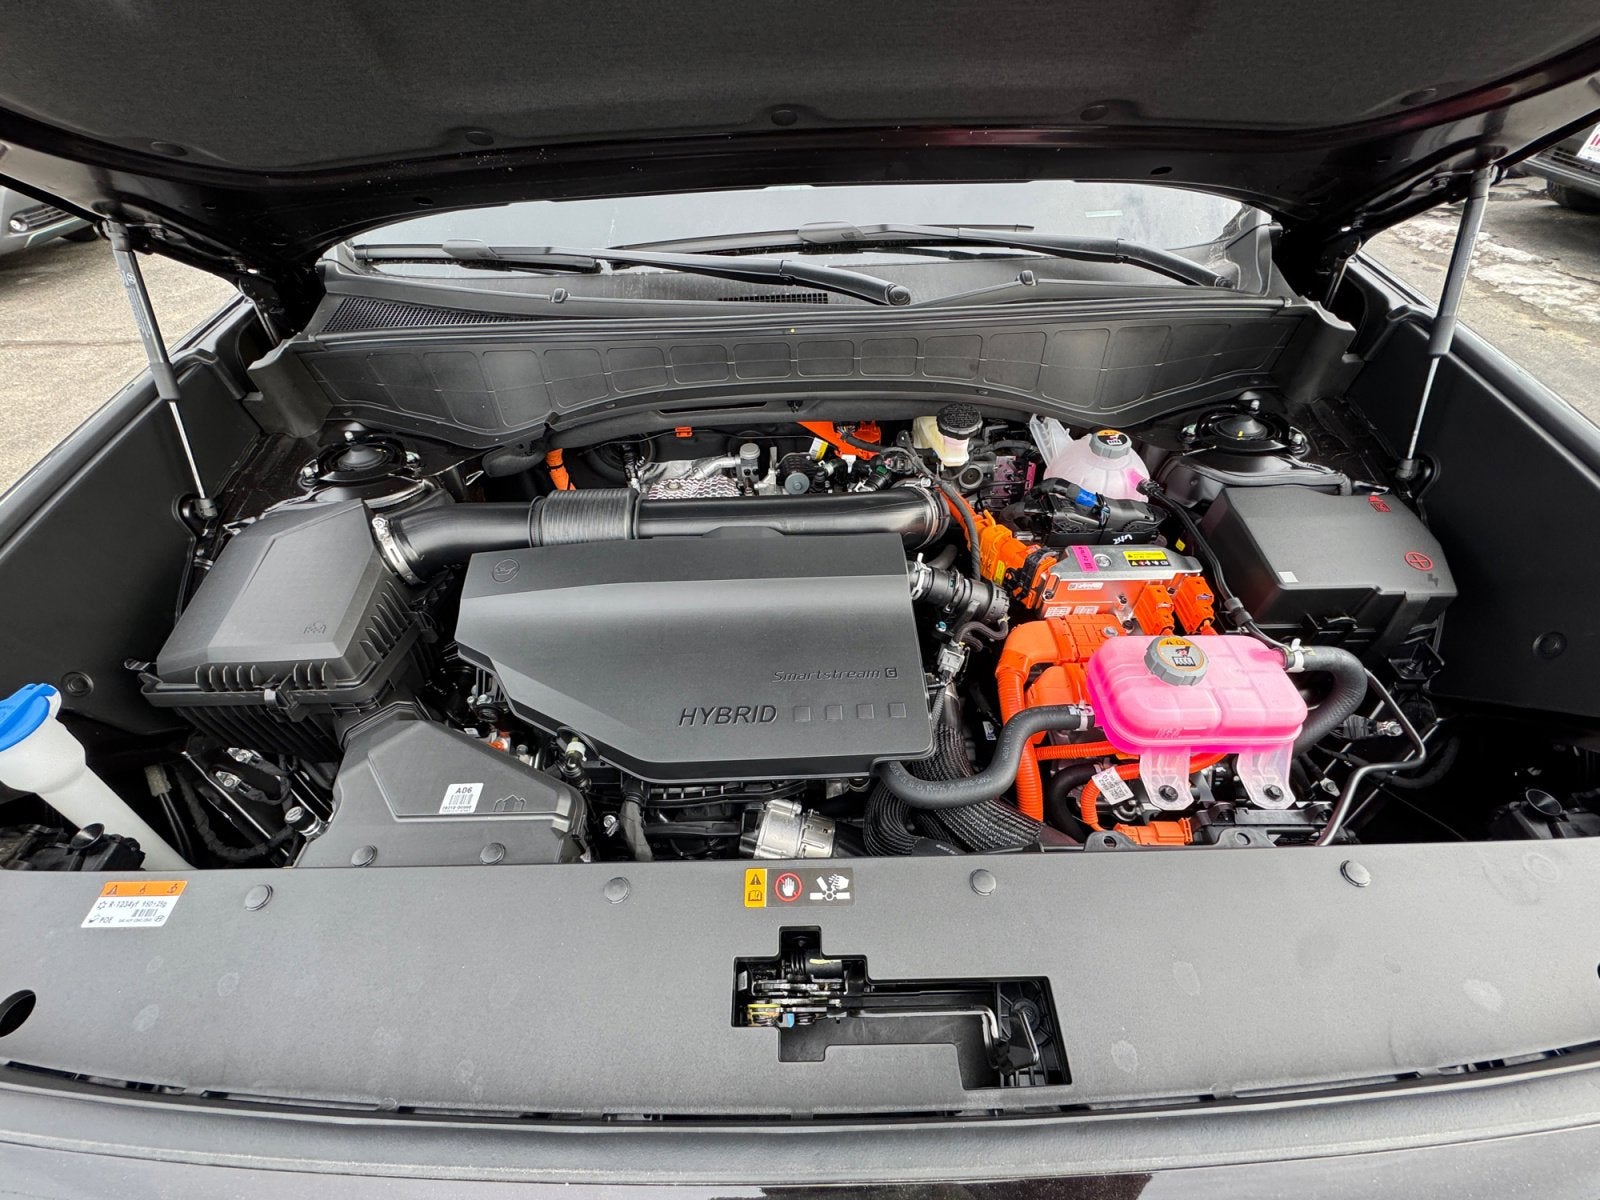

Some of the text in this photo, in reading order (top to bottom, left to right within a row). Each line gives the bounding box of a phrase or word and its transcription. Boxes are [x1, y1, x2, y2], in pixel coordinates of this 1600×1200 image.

[772, 667, 899, 682] Smartstream G
[678, 704, 778, 727] HYBRID
